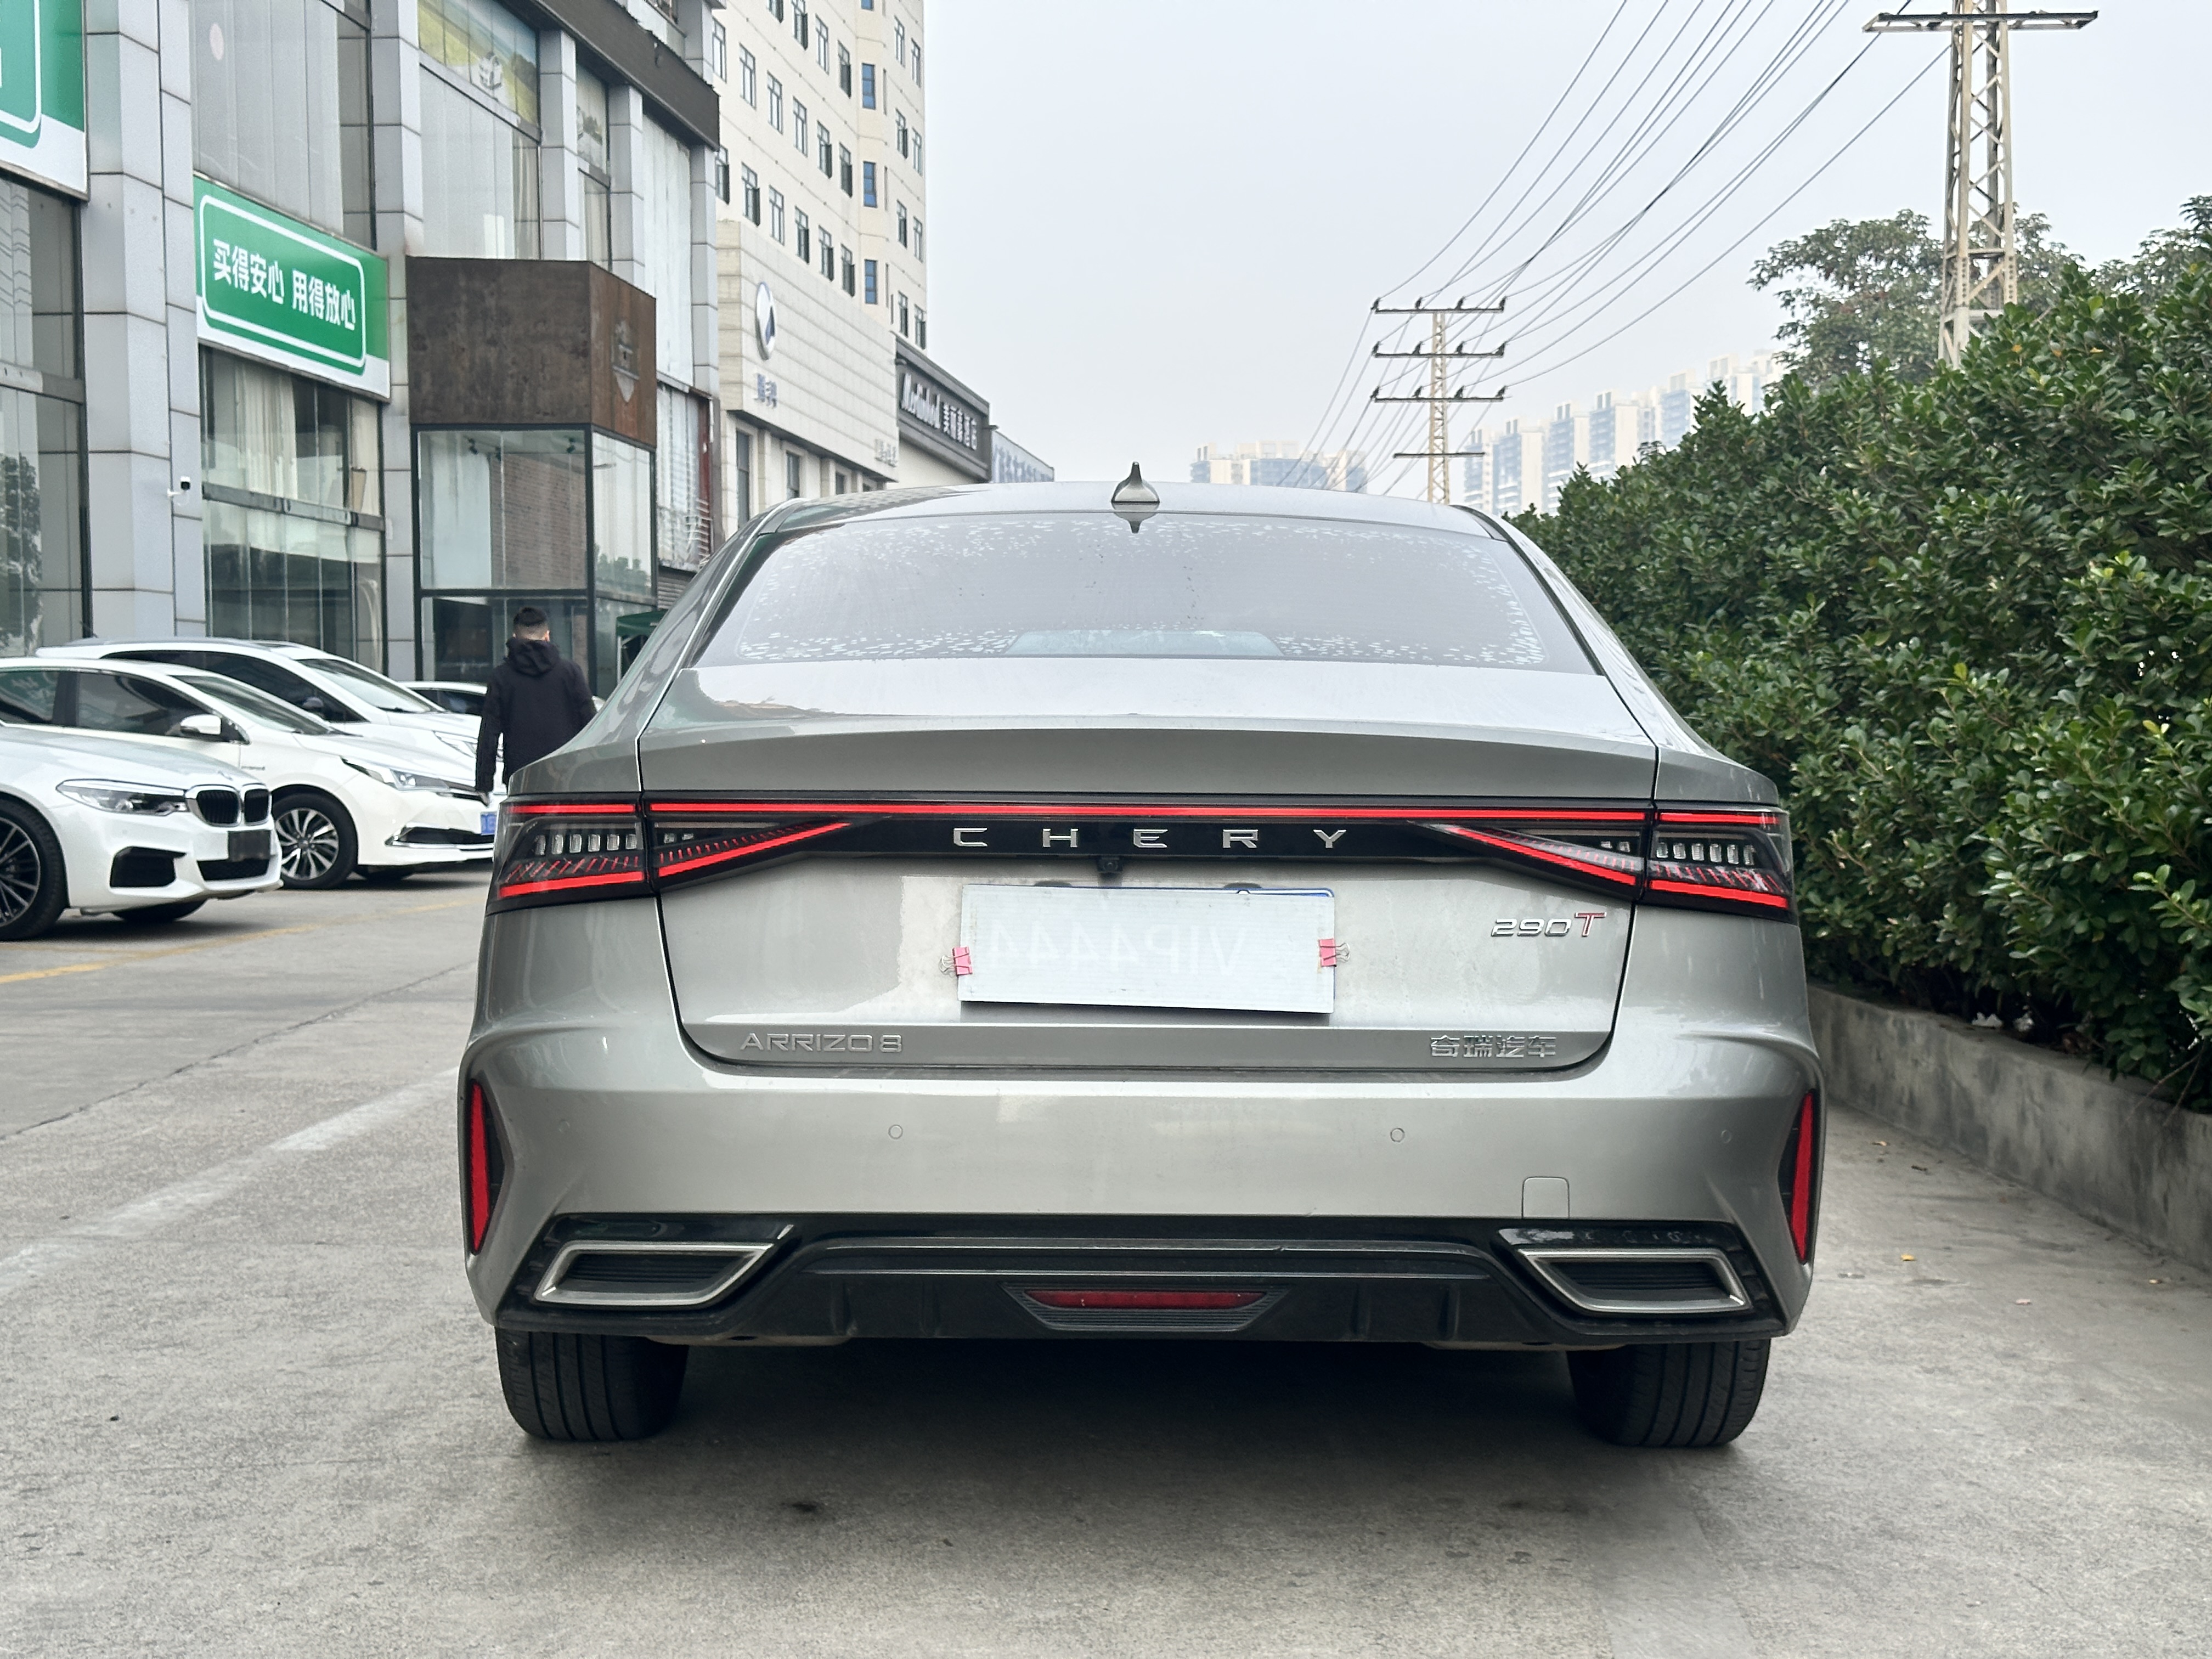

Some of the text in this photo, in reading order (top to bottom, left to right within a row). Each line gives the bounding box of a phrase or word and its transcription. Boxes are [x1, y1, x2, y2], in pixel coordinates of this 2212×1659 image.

[213, 238, 356, 331] 买得安心 用得放心
[953, 827, 1347, 849] CHERY
[1491, 911, 1607, 938] 290T
[740, 1032, 902, 1053] ARRIZO 8
[1430, 1035, 1557, 1058] 奇瑞汽车
